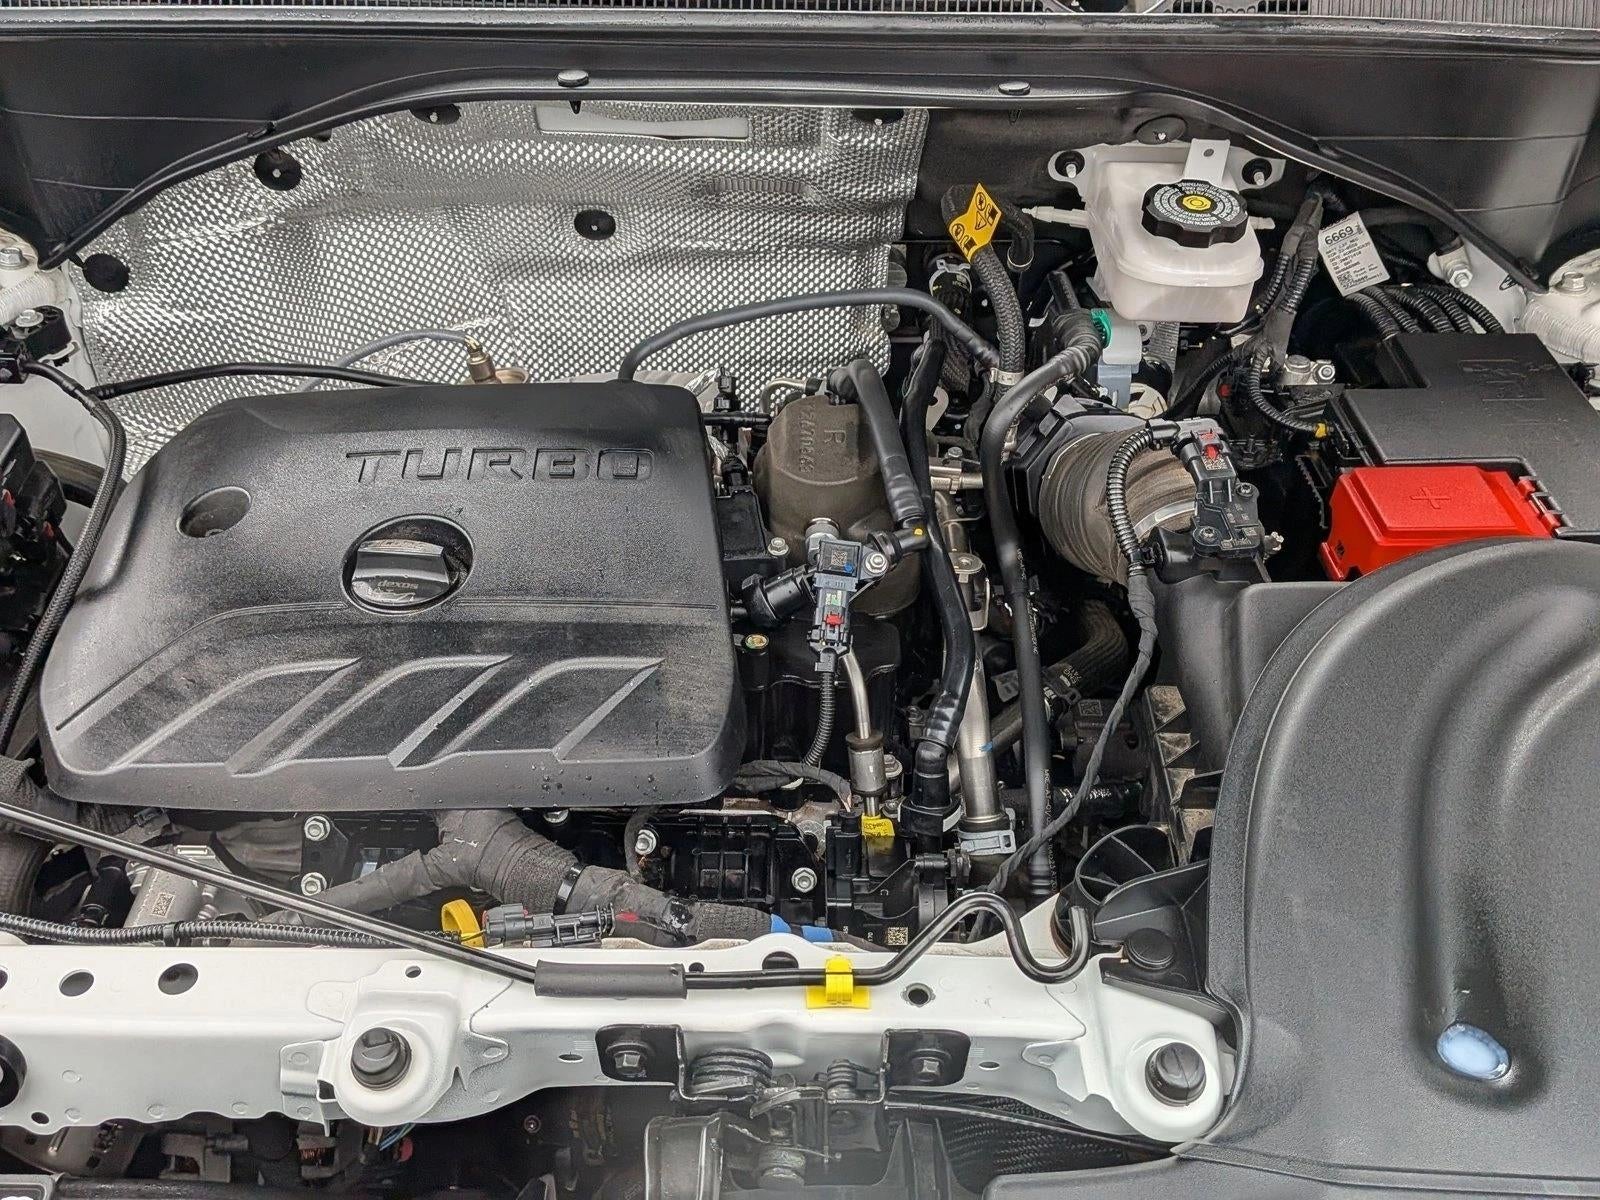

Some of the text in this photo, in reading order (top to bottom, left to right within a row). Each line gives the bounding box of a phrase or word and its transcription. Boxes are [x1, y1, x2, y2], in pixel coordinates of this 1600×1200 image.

[1324, 226, 1354, 245] 6669
[346, 448, 654, 483] TURBO
[377, 579, 419, 590] dexos
